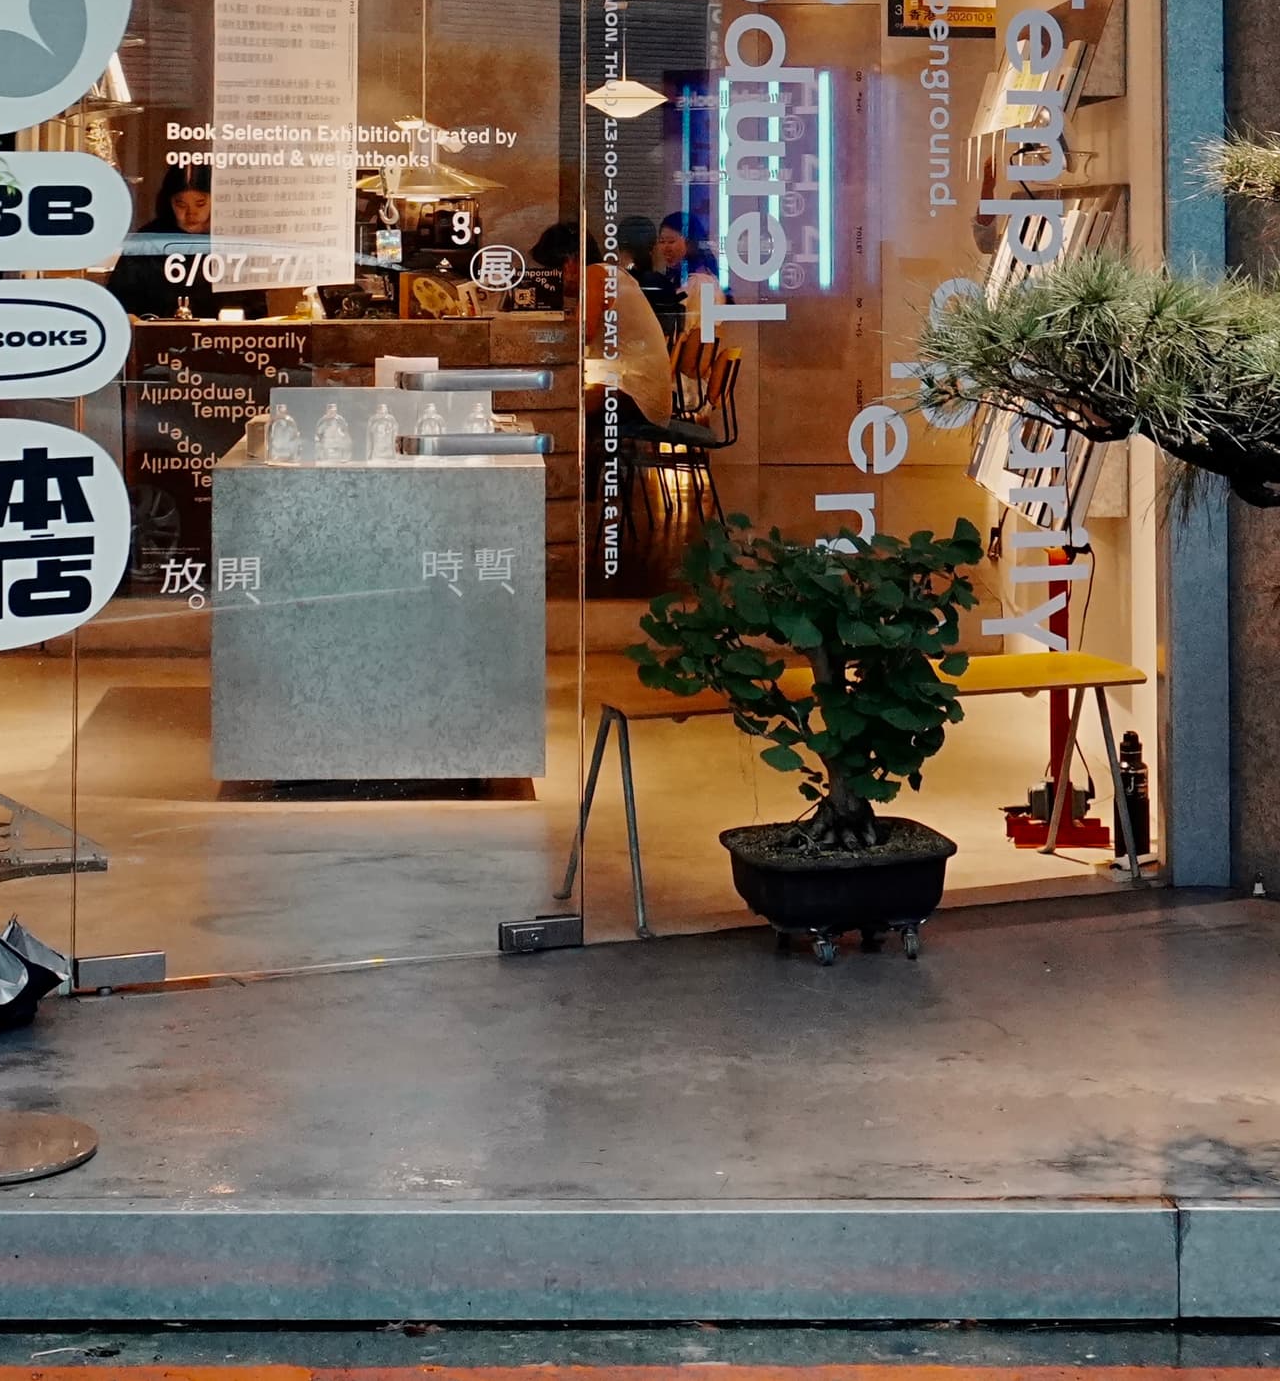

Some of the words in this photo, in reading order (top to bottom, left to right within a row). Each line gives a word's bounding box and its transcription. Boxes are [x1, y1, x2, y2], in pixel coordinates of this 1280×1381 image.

[166, 122, 217, 141] Book
[221, 124, 312, 142] Selection
[495, 128, 518, 149] by
[166, 149, 284, 168] openground
[290, 150, 305, 166] &
[309, 151, 430, 169] weightbooks
[191, 332, 307, 354] Temporarily
[604, 456, 618, 504] TUE.
[604, 523, 618, 580] WED.
